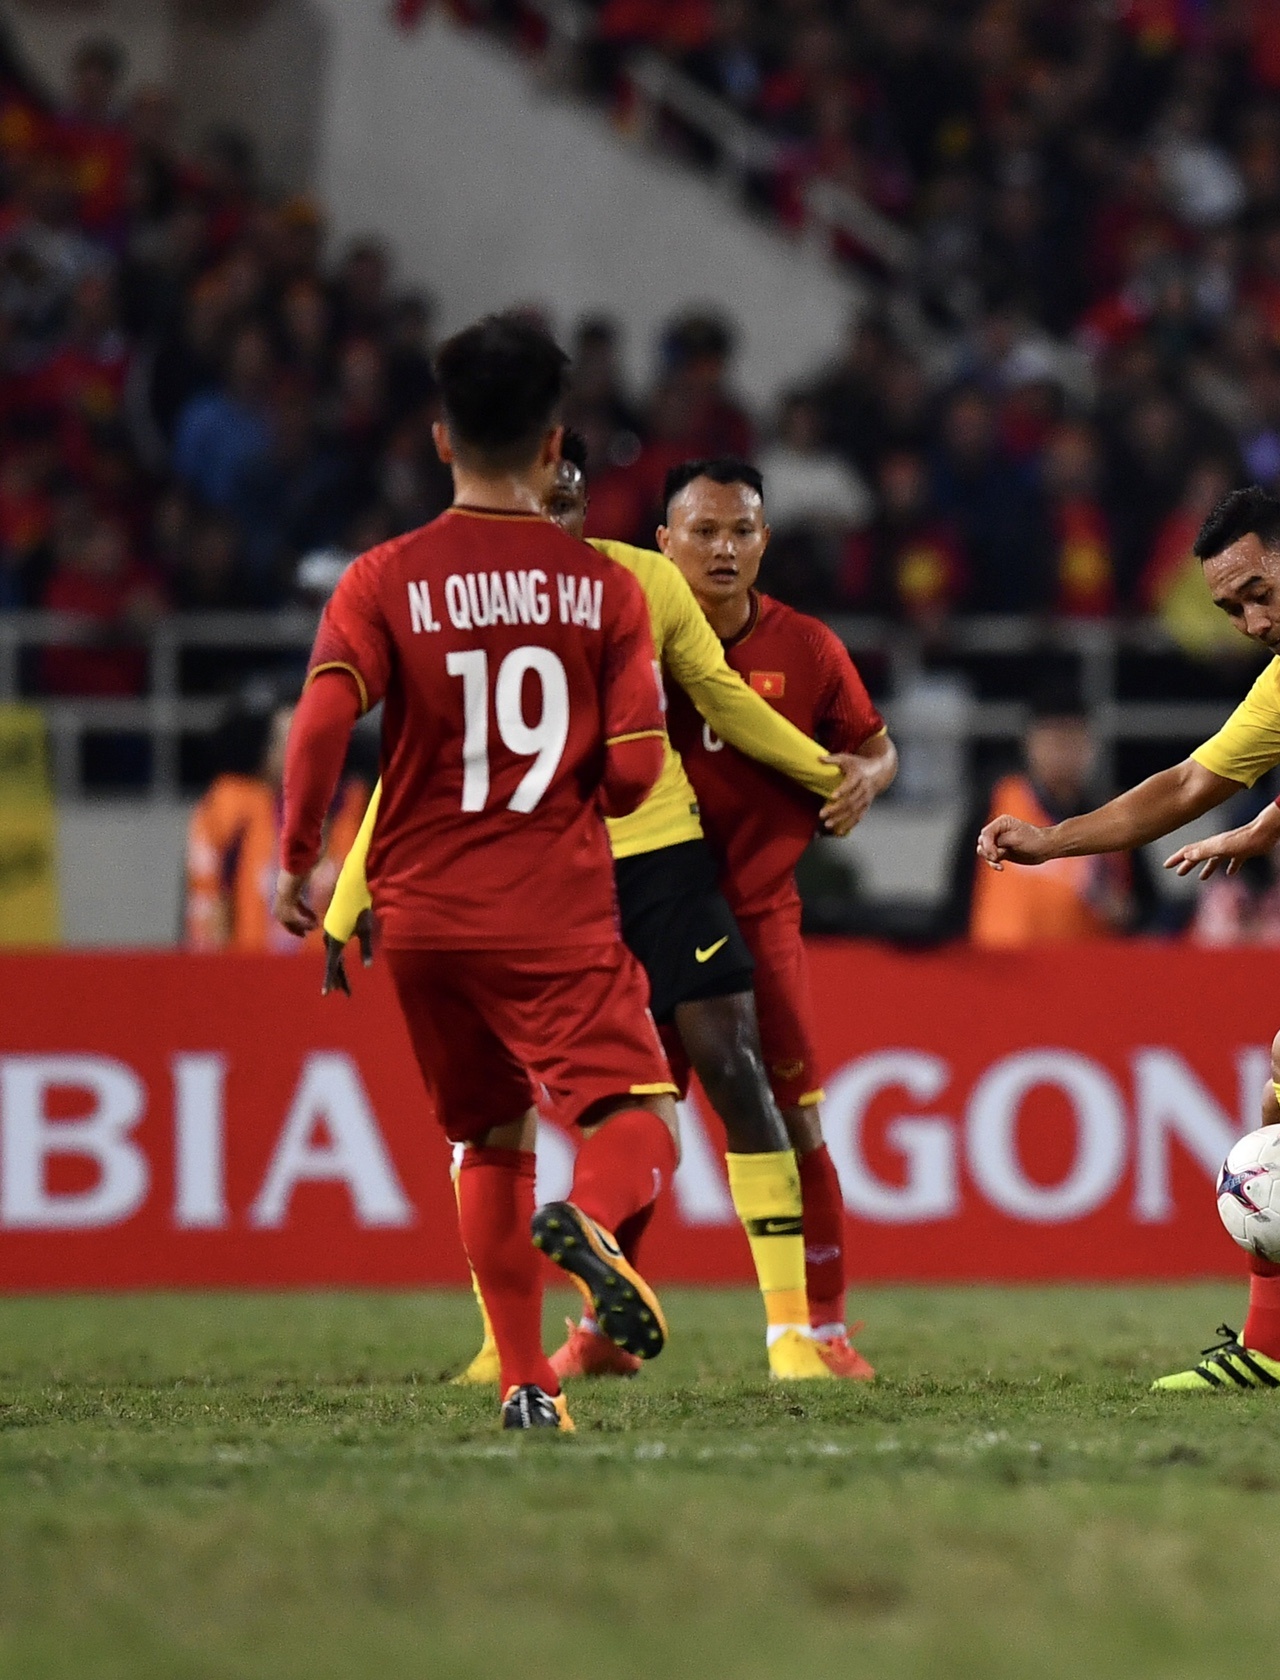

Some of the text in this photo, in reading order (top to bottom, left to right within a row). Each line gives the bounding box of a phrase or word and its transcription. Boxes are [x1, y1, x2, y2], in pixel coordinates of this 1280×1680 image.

[407, 568, 604, 634] N. QUANG HAI
[445, 645, 570, 815] 19
[0, 1050, 416, 1230] BIA
